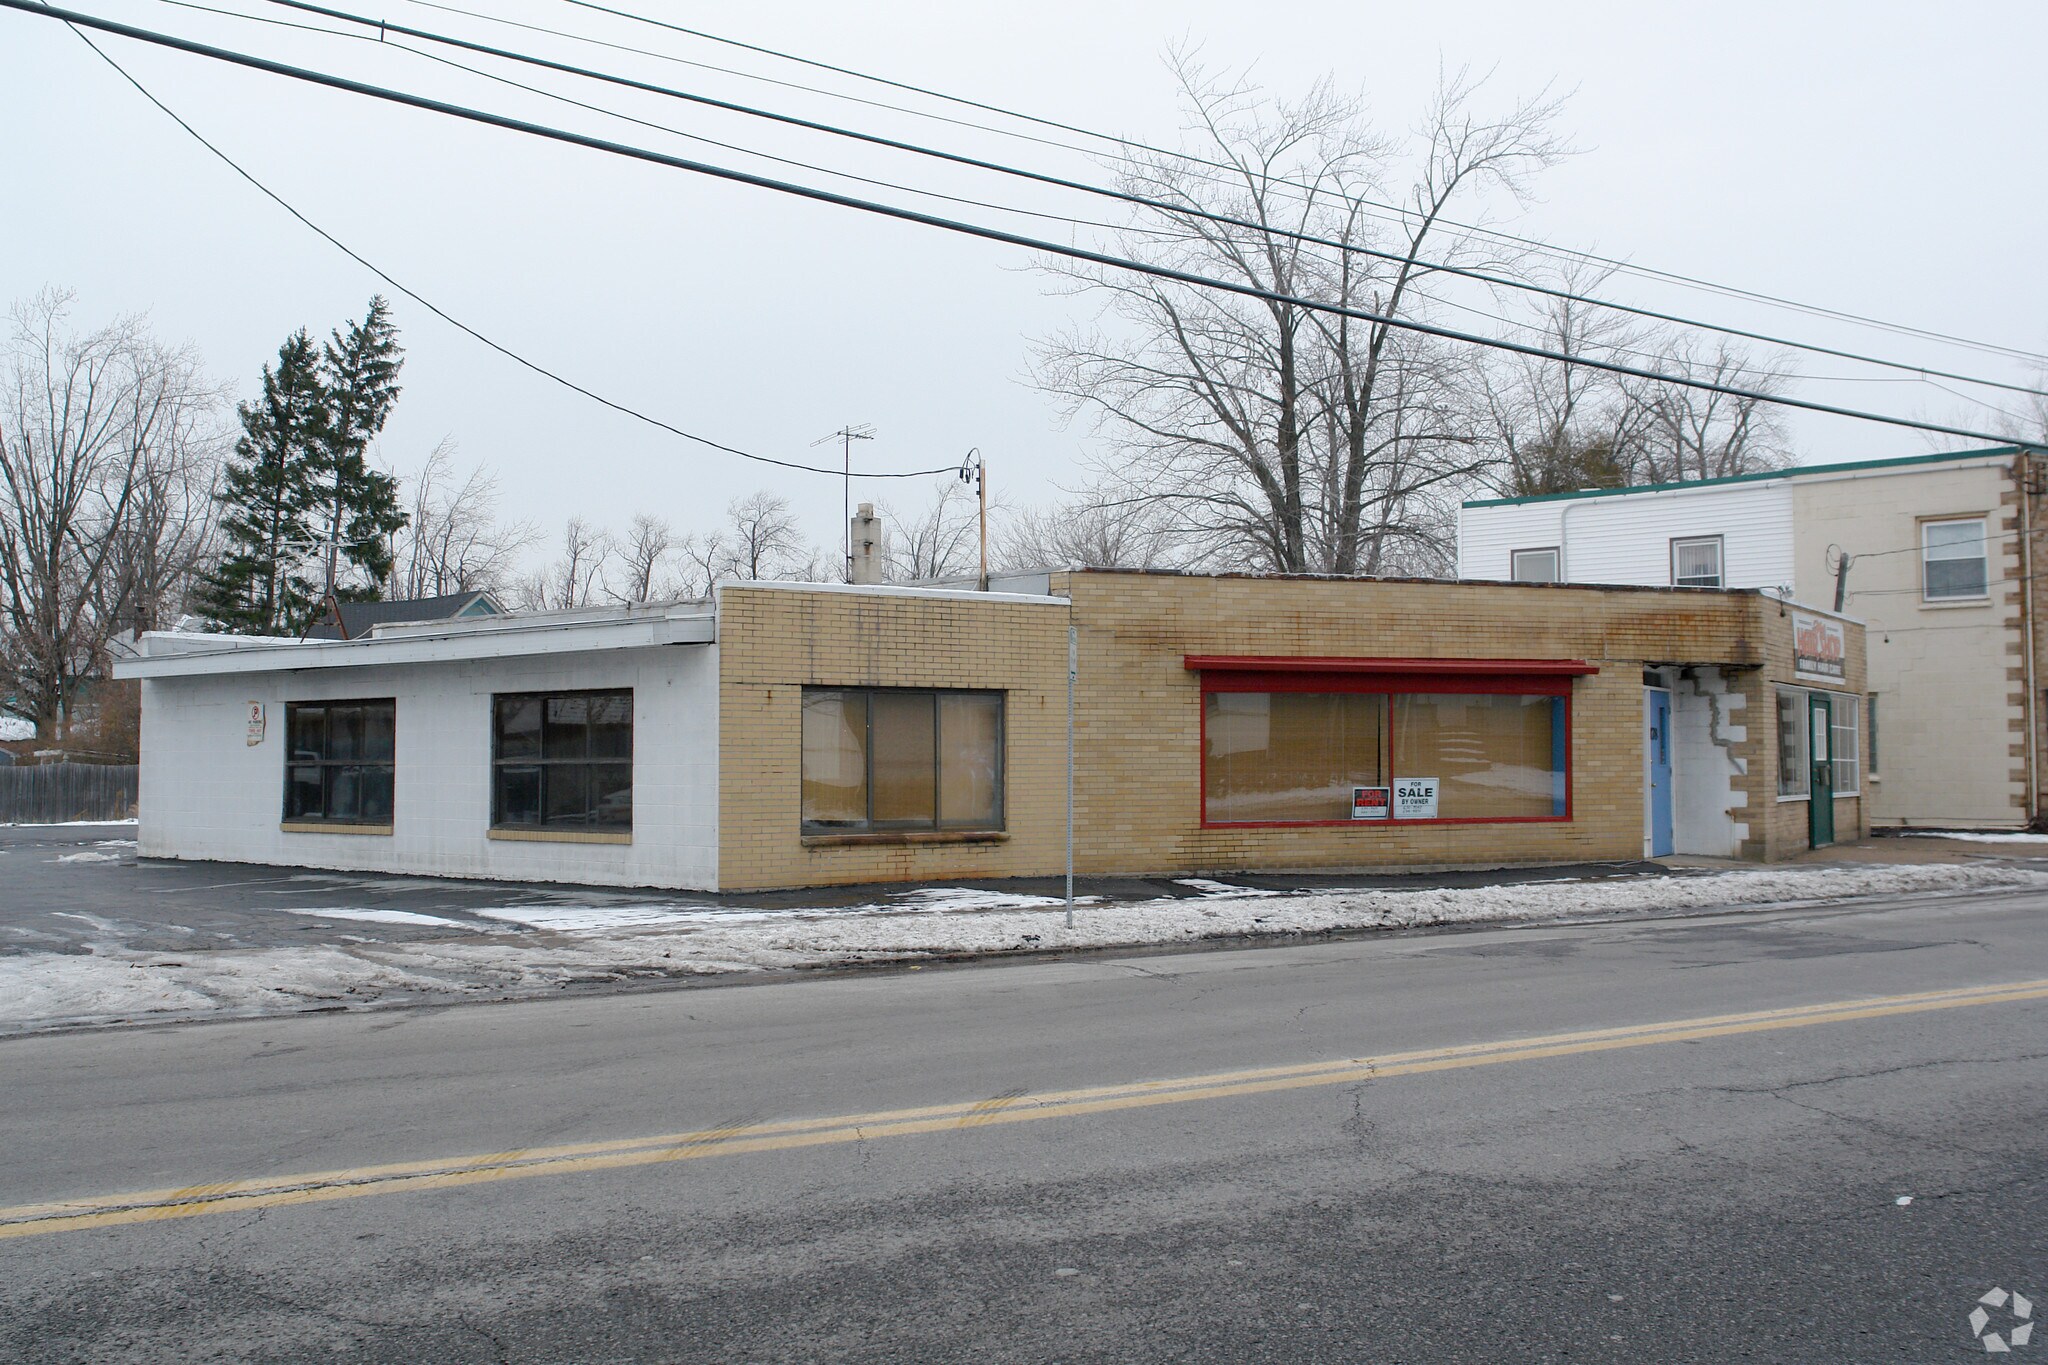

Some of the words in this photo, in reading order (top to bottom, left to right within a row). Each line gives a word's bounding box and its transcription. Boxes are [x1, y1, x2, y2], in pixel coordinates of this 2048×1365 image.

[1799, 659, 1816, 671] FAMILY
[1829, 663, 1841, 675] CARE
[1361, 790, 1382, 798] FOR
[1398, 788, 1433, 797] SALE
[1356, 798, 1386, 806] RENT
